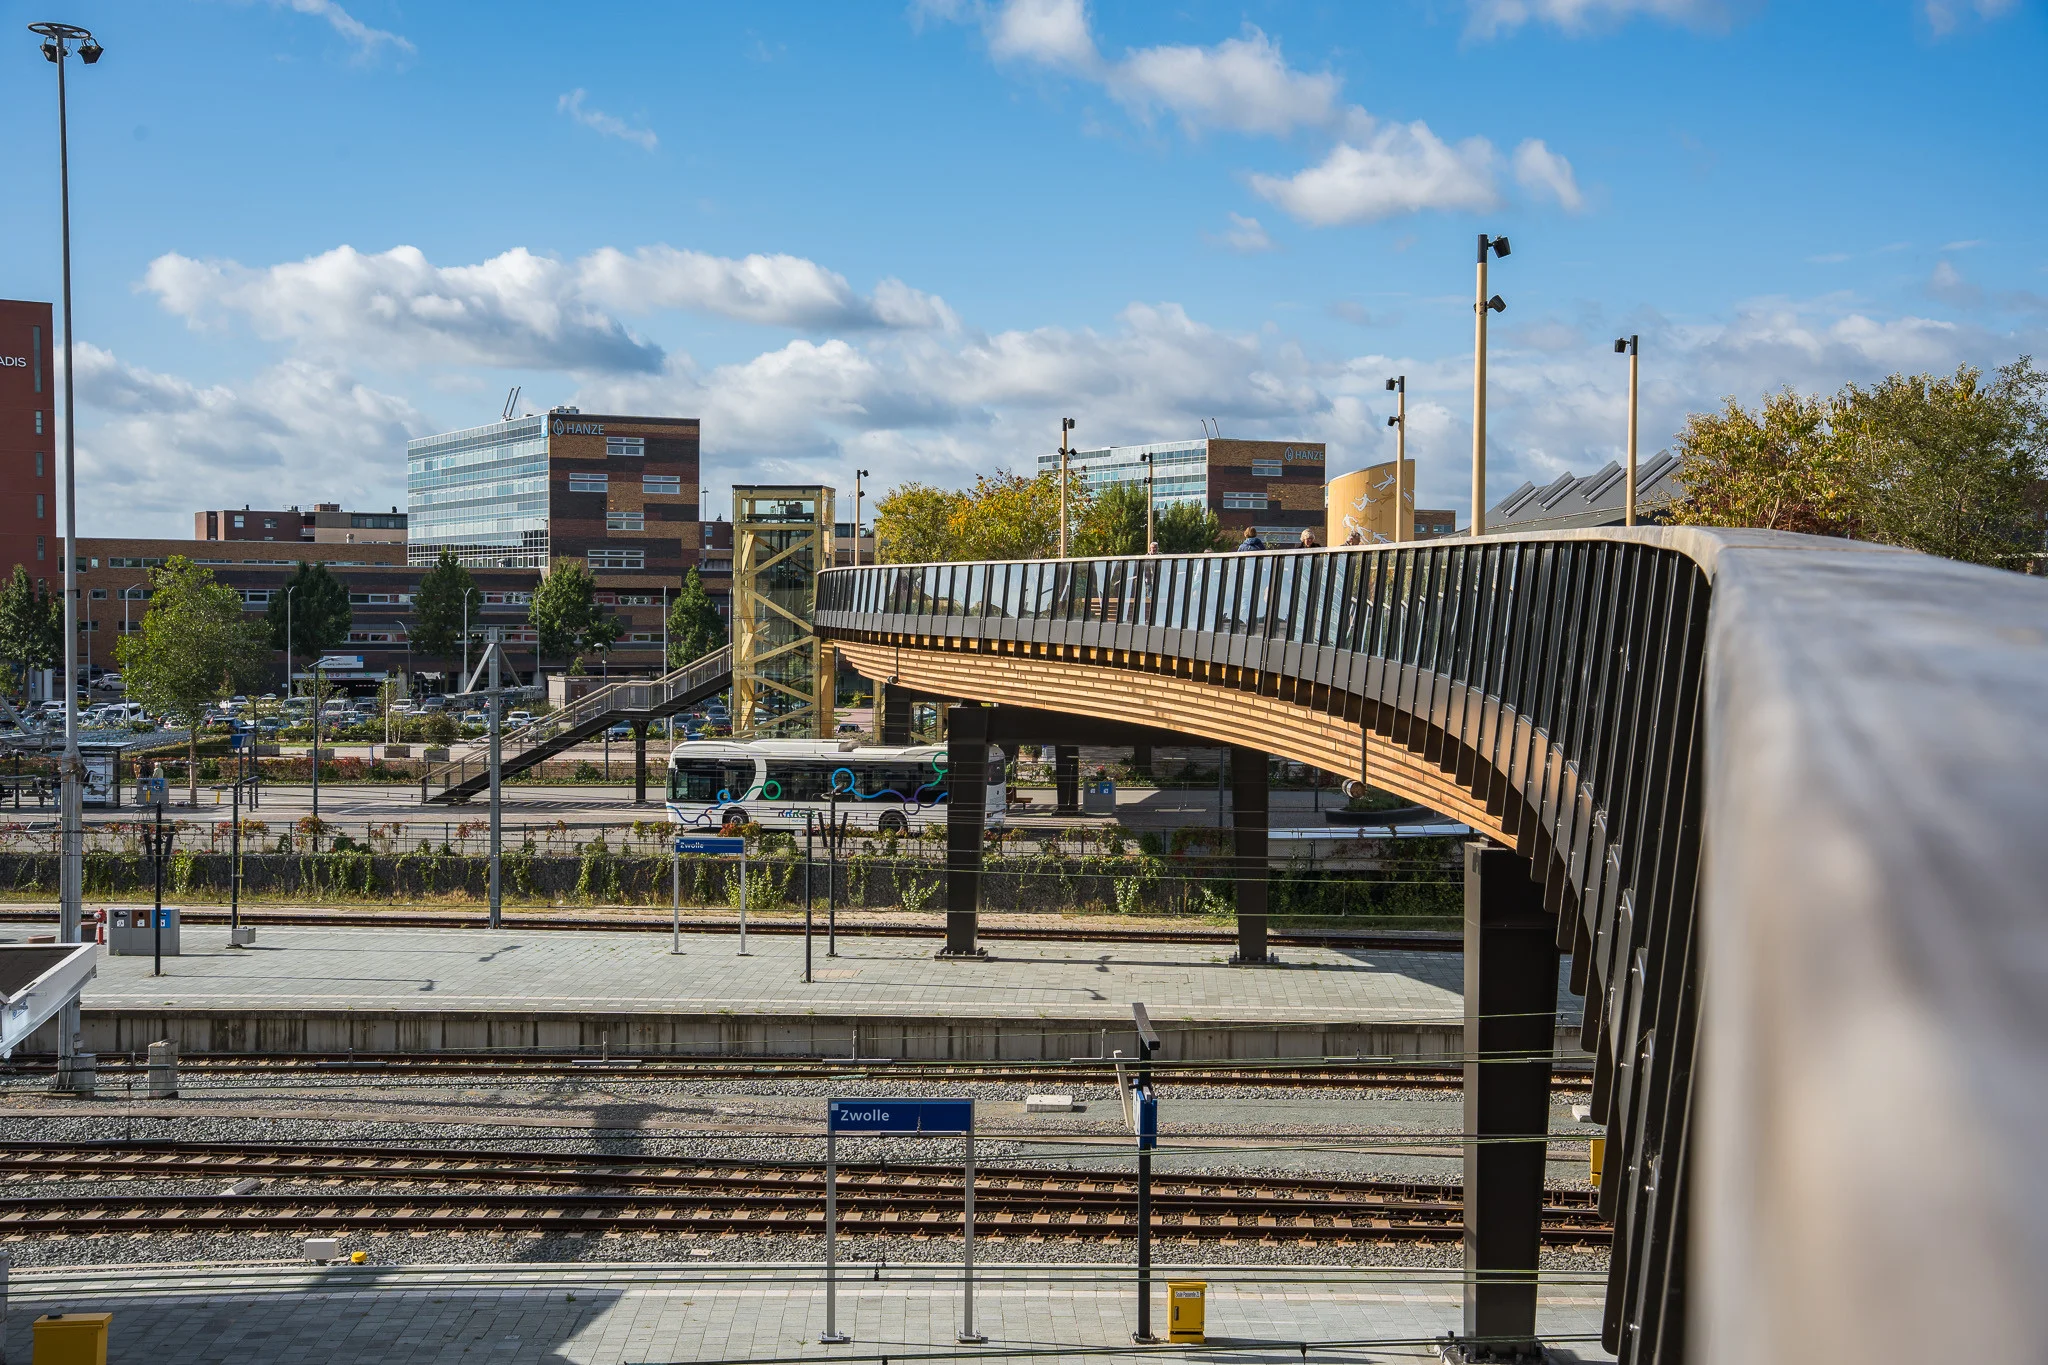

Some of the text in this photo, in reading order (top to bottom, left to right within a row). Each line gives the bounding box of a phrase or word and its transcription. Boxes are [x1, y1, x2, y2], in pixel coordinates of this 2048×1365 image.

[566, 423, 605, 435] HANZE
[1295, 450, 1324, 461] HANZE
[680, 841, 704, 849] Zwolle
[840, 1109, 890, 1122] Zwolle
